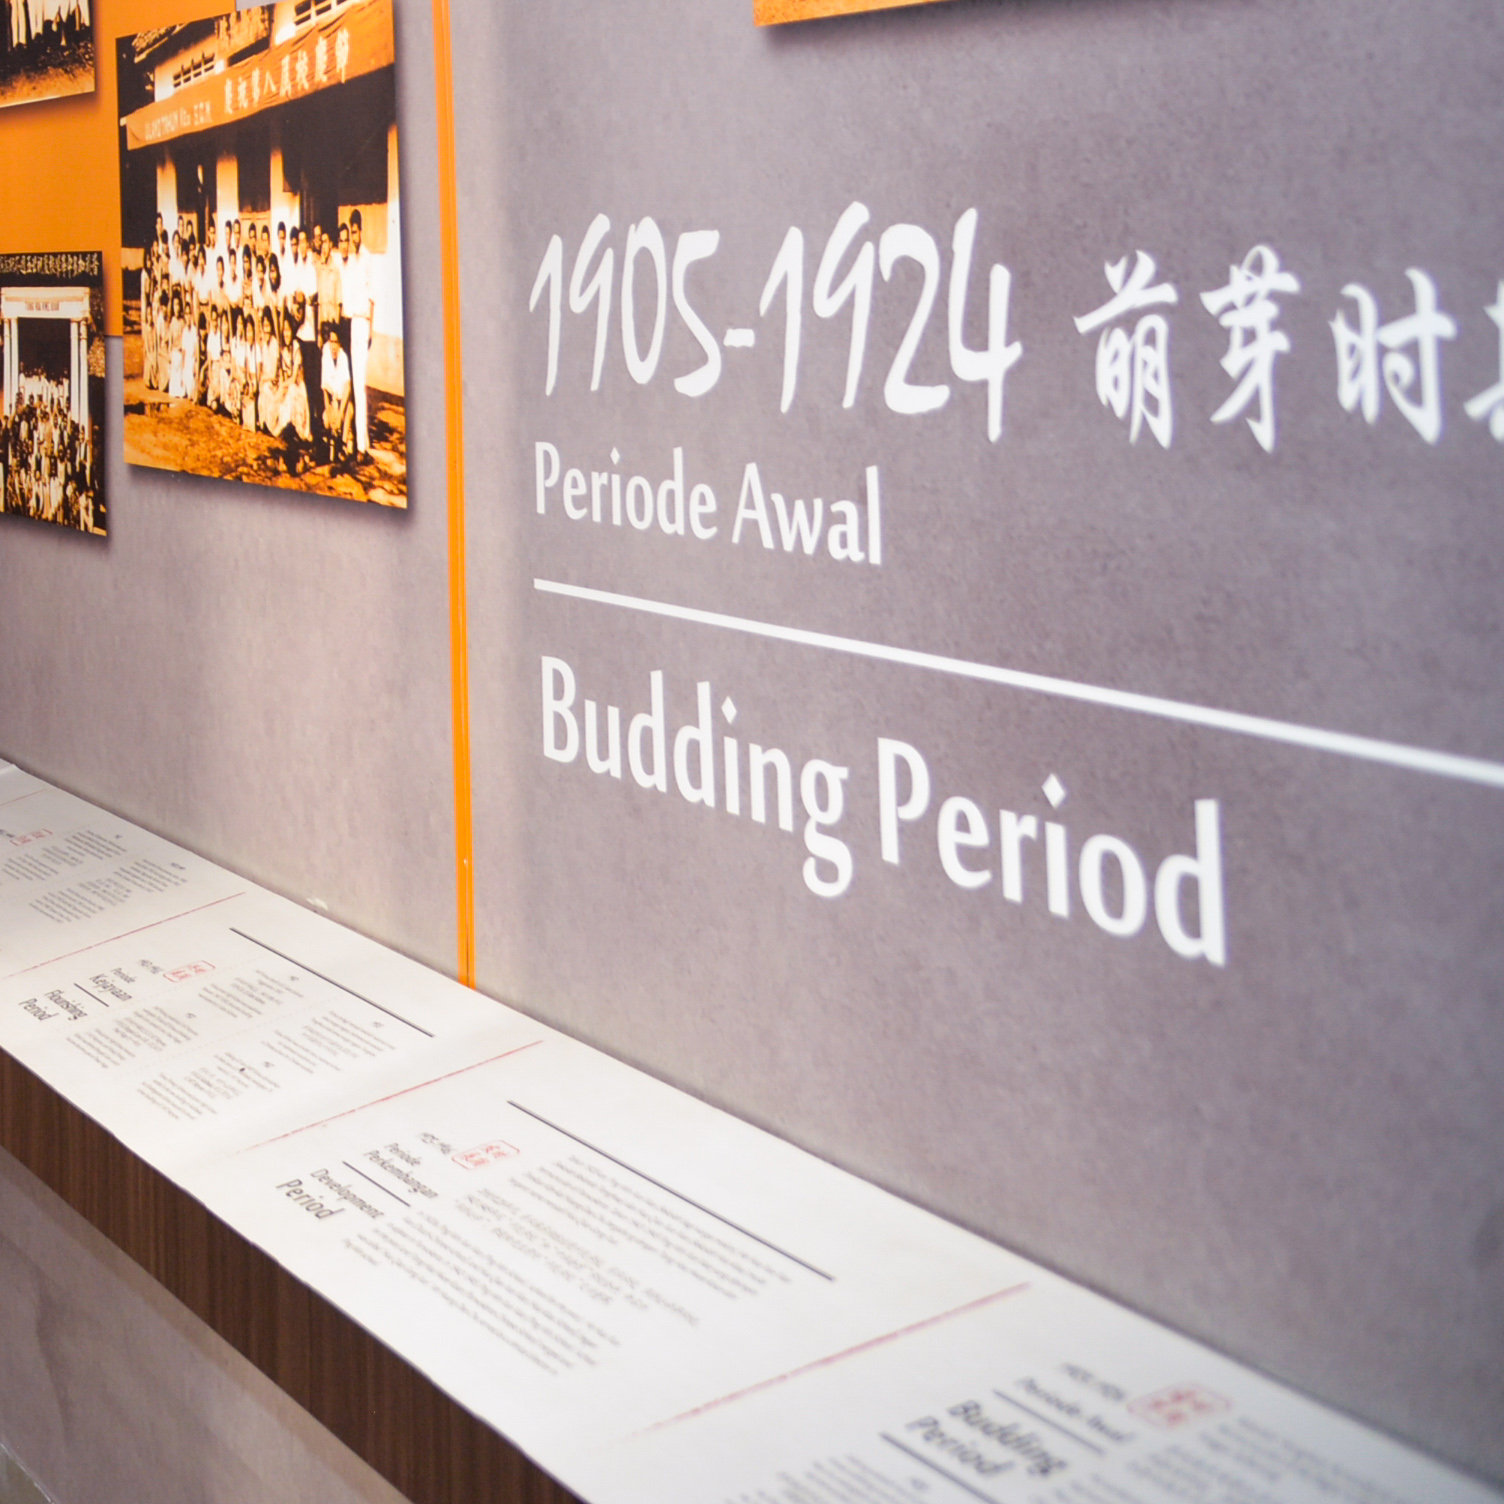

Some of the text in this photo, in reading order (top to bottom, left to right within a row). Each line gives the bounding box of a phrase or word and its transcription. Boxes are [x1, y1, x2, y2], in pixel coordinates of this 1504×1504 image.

[529, 202, 1023, 443] 1905-1924
[534, 440, 883, 566] Periode Awal
[540, 655, 1227, 967] Budding Period
[276, 1178, 345, 1220] Period
[310, 1168, 385, 1219] Development
[904, 1415, 1016, 1476] Period
[947, 1398, 1069, 1478] Budding
